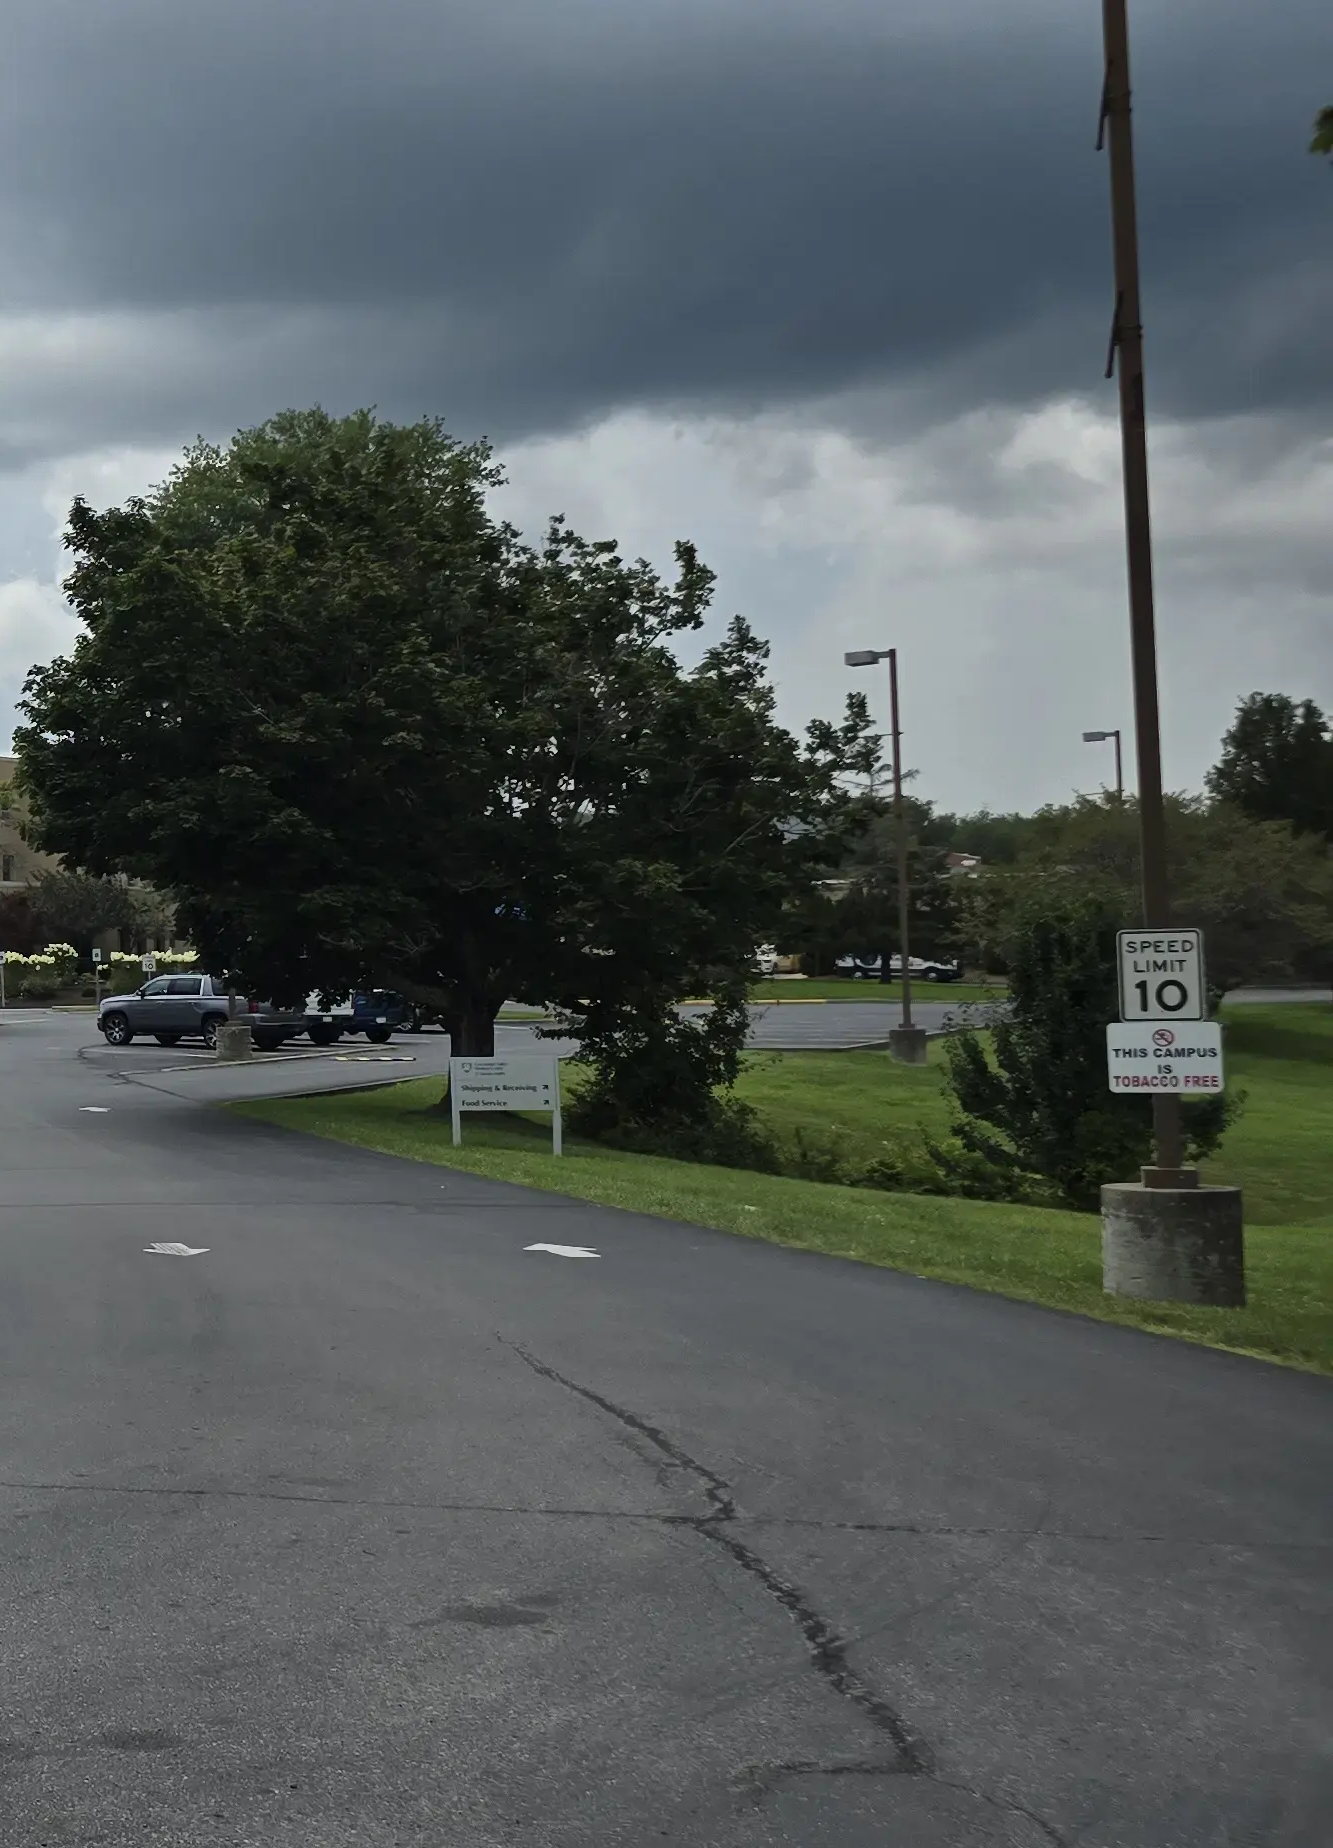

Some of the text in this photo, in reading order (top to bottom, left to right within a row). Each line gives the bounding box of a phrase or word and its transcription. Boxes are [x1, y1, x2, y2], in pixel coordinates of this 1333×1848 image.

[1125, 939, 1194, 953] SPEED
[1134, 960, 1187, 973] LIMIT
[1135, 979, 1188, 1012] 10
[1112, 1048, 1218, 1058] THIS CAMPUS
[1158, 1064, 1173, 1074] IS
[1113, 1075, 1219, 1088] TOBACCO FREE
